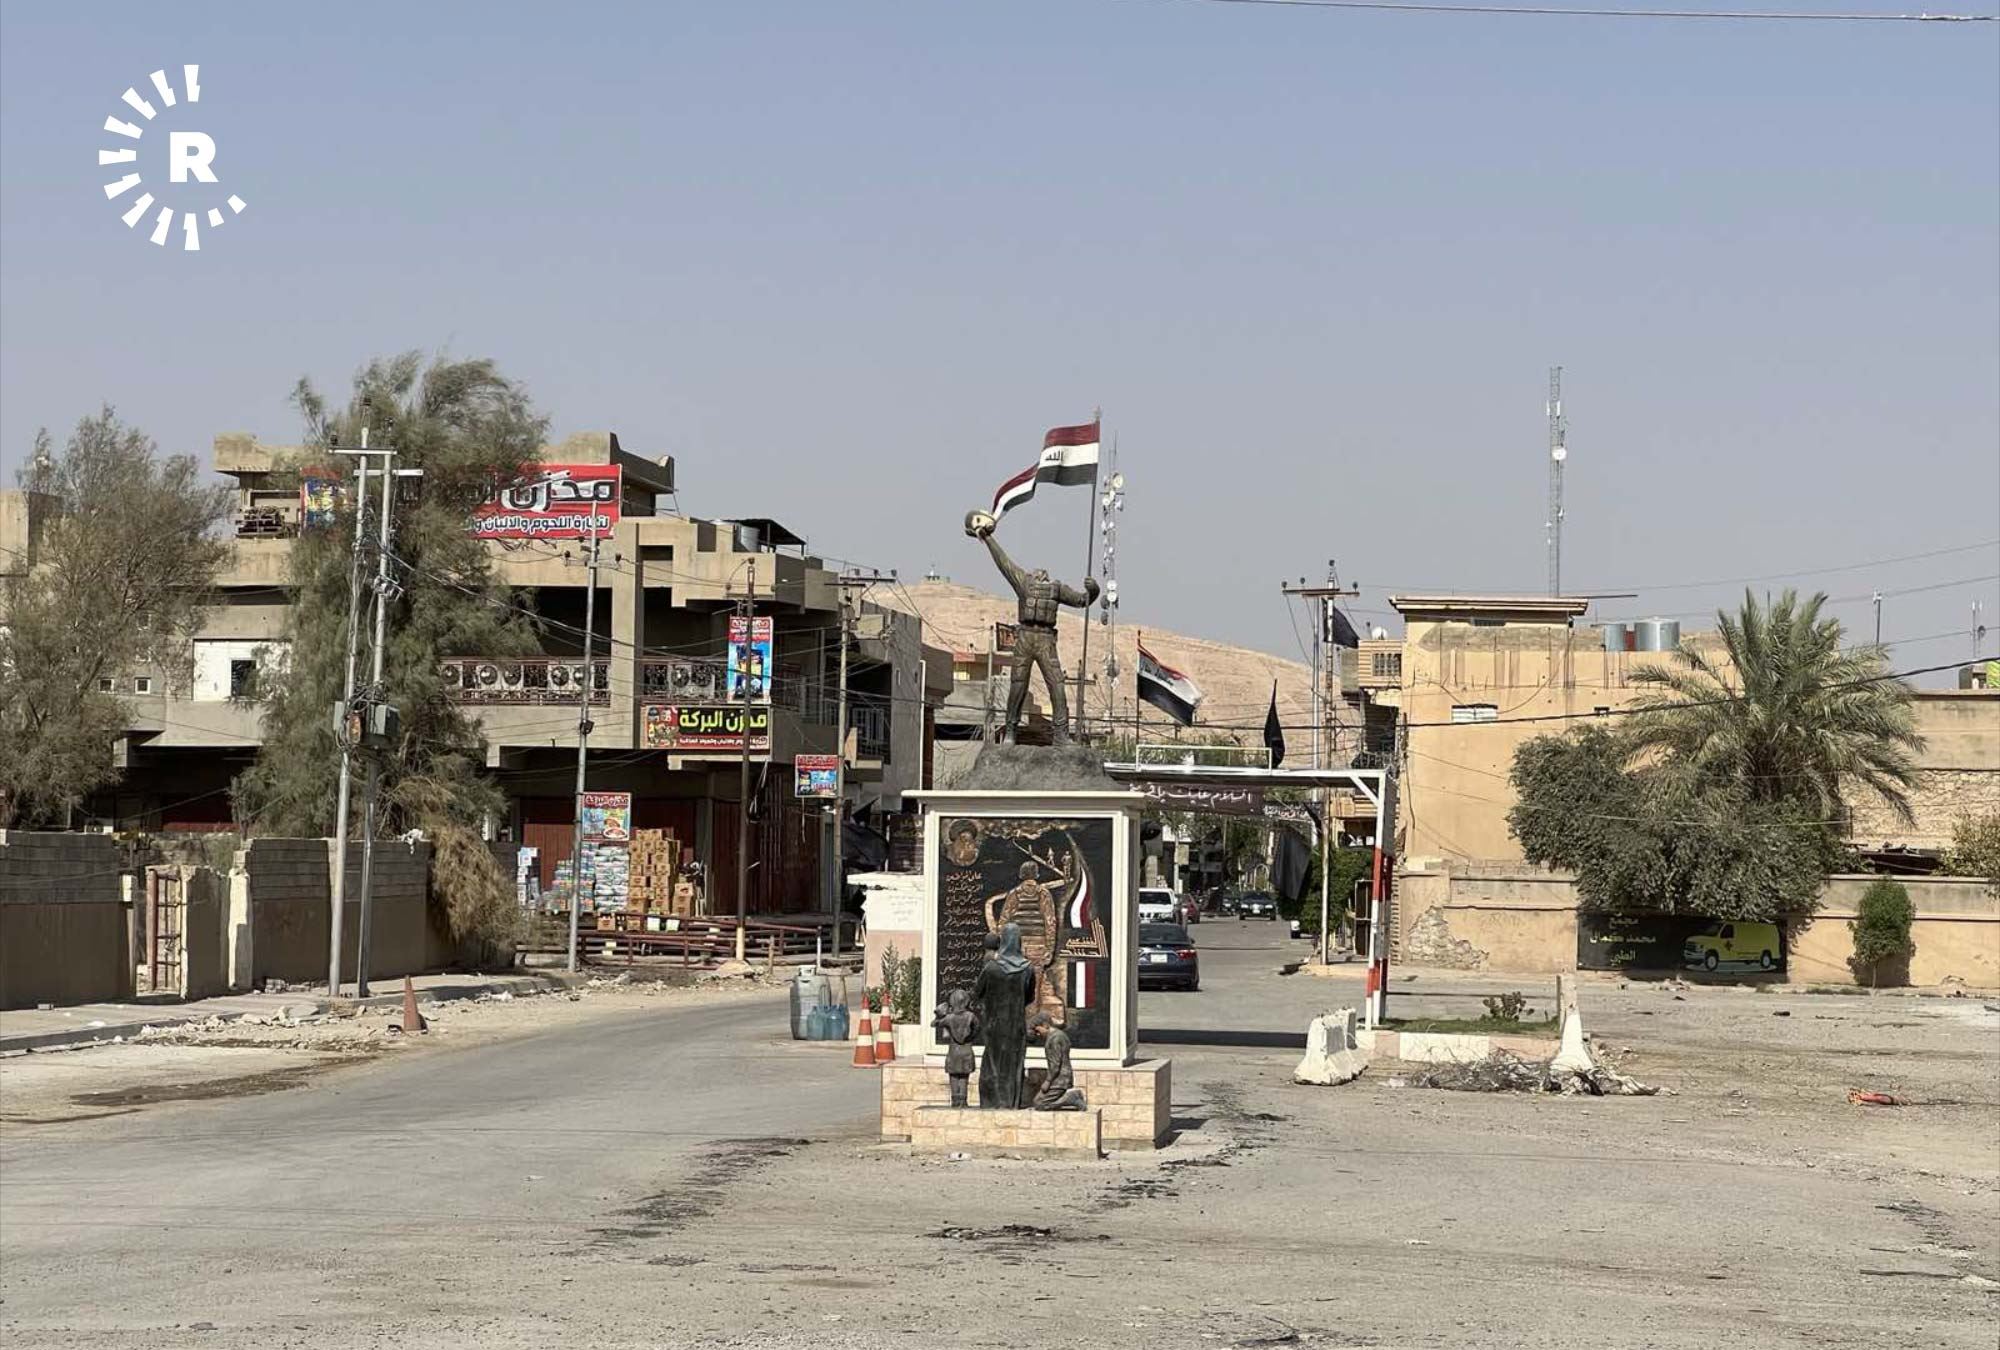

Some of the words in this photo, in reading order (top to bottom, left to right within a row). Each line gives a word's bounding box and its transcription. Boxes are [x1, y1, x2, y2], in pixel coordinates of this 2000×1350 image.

[530, 514, 573, 534] اللحوم
[679, 710, 724, 733] البركة
[1210, 788, 1252, 809] السلام
